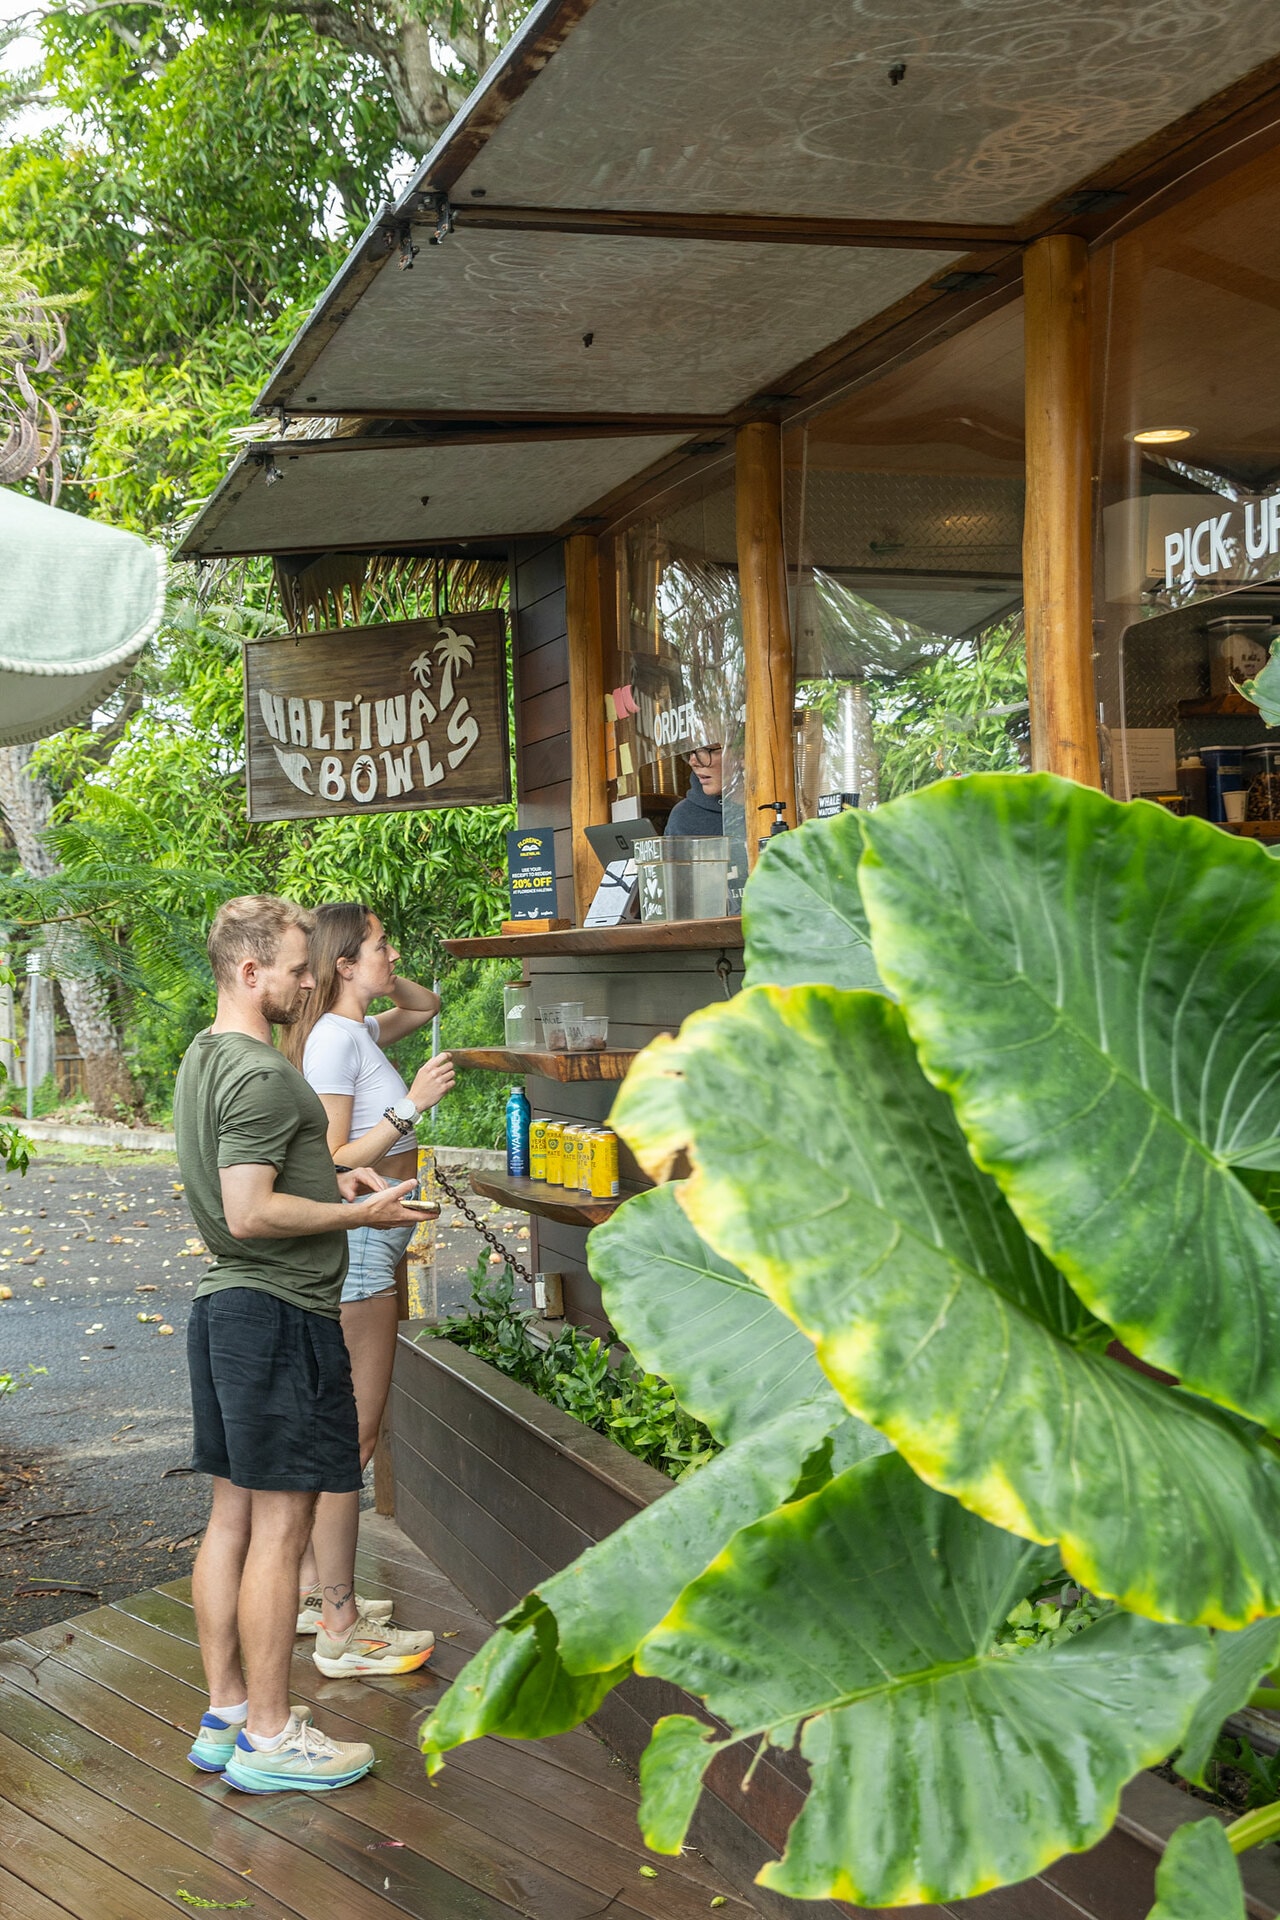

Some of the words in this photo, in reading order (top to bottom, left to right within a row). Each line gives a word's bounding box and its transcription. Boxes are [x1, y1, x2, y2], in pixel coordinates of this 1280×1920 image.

[1165, 512, 1232, 589] PICK
[654, 700, 695, 747] ORDER
[634, 839, 662, 861] SHARE
[512, 878, 532, 889] 20%
[533, 876, 553, 888] OFF
[643, 864, 658, 879] THE
